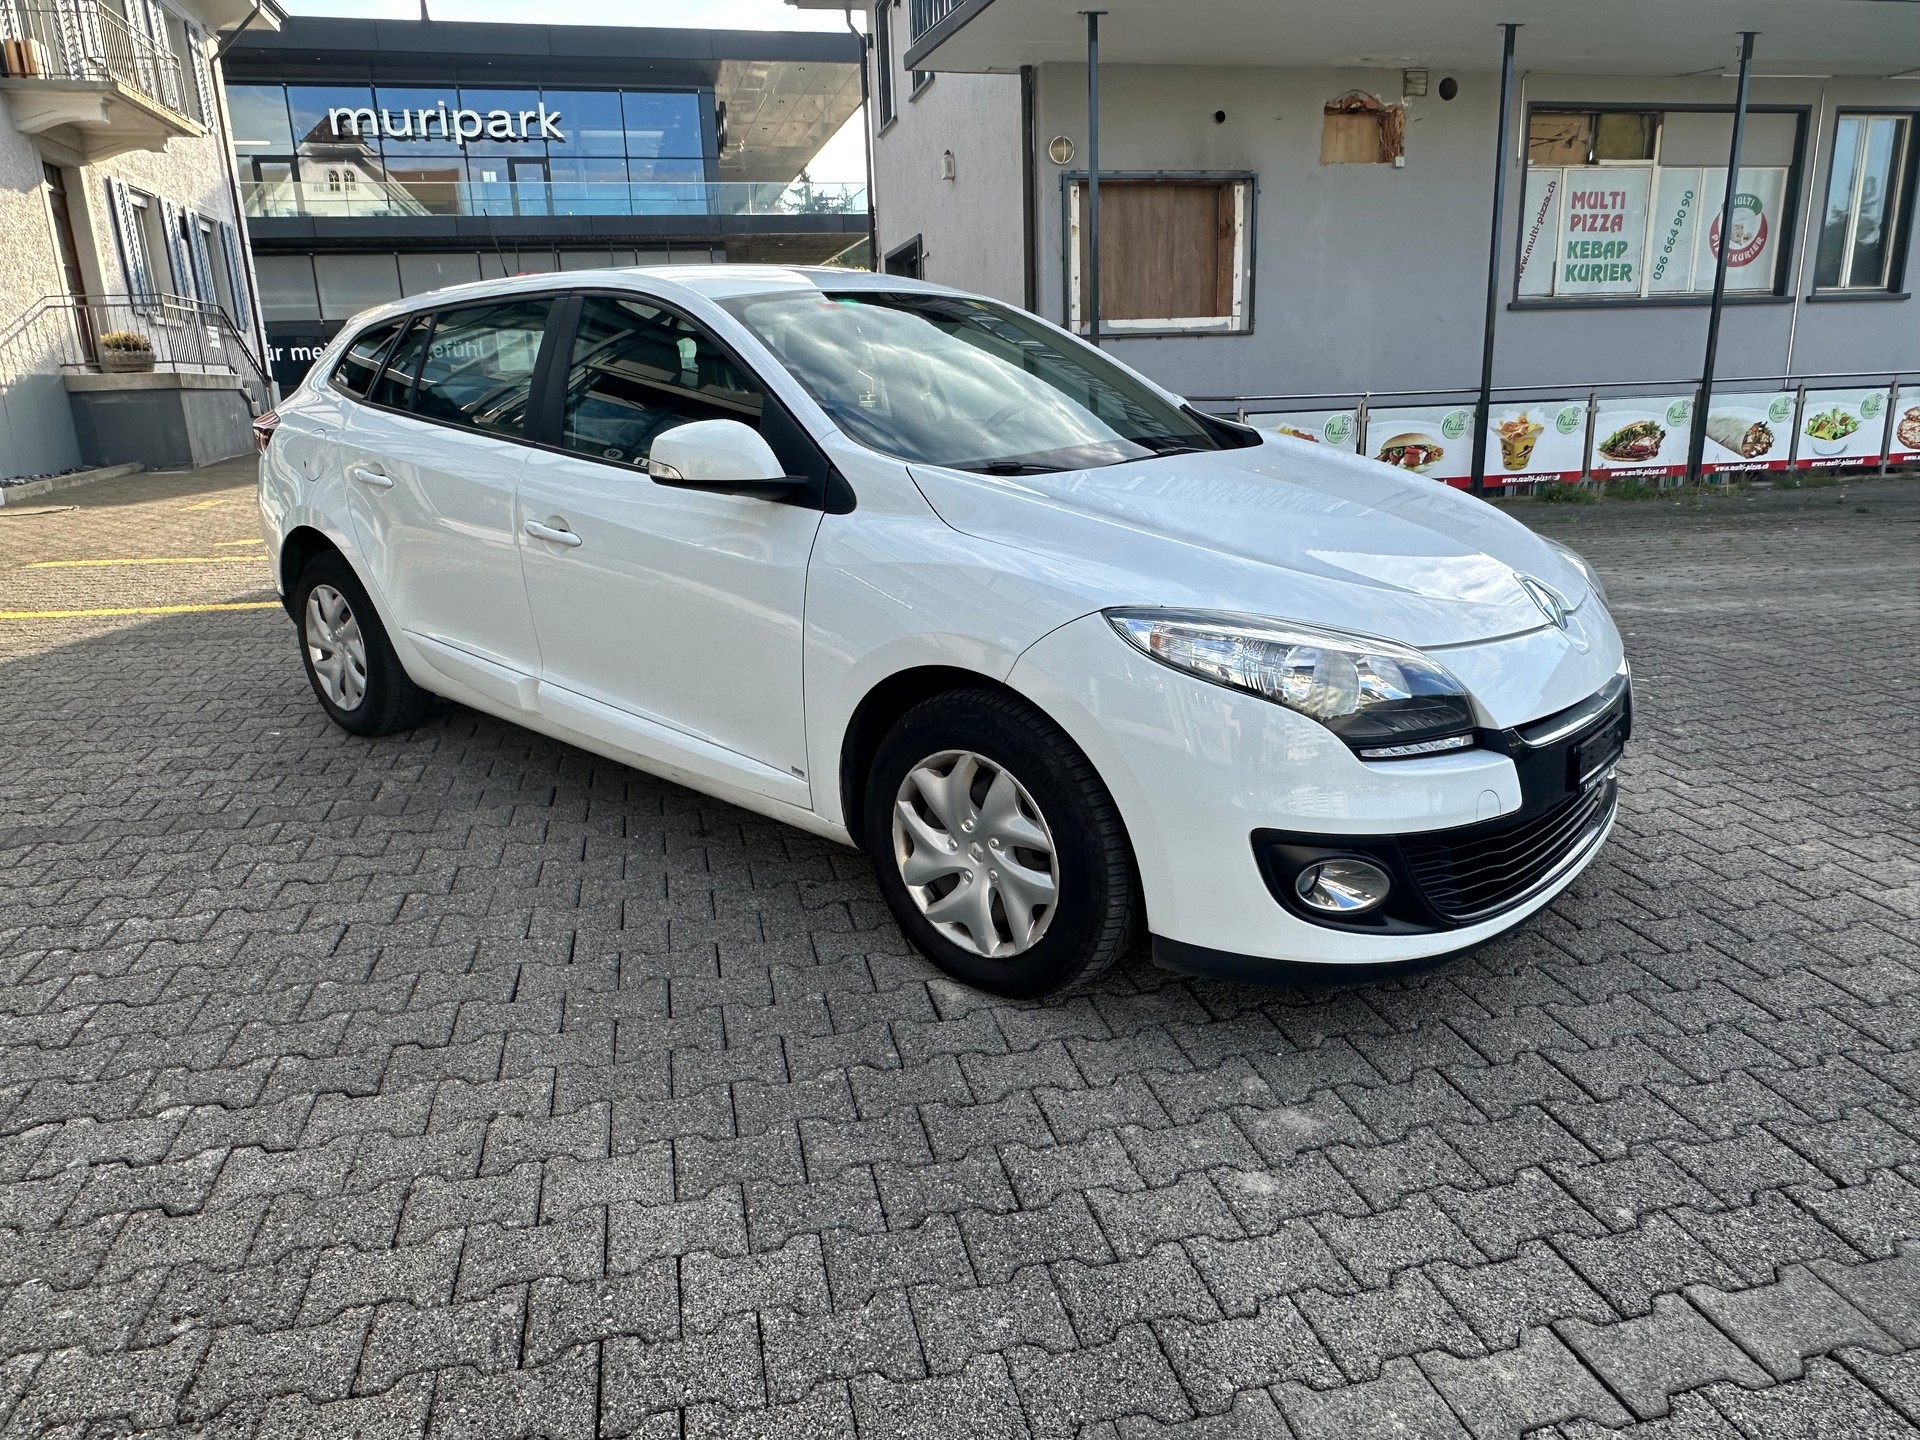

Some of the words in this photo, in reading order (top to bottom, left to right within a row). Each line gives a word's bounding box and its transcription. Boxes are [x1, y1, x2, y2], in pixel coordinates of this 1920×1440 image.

[329, 100, 565, 145] muripark
[1571, 191, 1626, 210] MULTI
[1519, 181, 1557, 279] ww.multi-pizza.ch
[1569, 213, 1624, 233] PIZZA
[1653, 255, 1669, 280] 056
[1663, 228, 1680, 254] 664
[1673, 209, 1687, 227] 90
[1681, 190, 1694, 208] 90
[1566, 240, 1629, 260] KEBAP
[1564, 263, 1633, 283] KURIER
[290, 342, 329, 361] me
